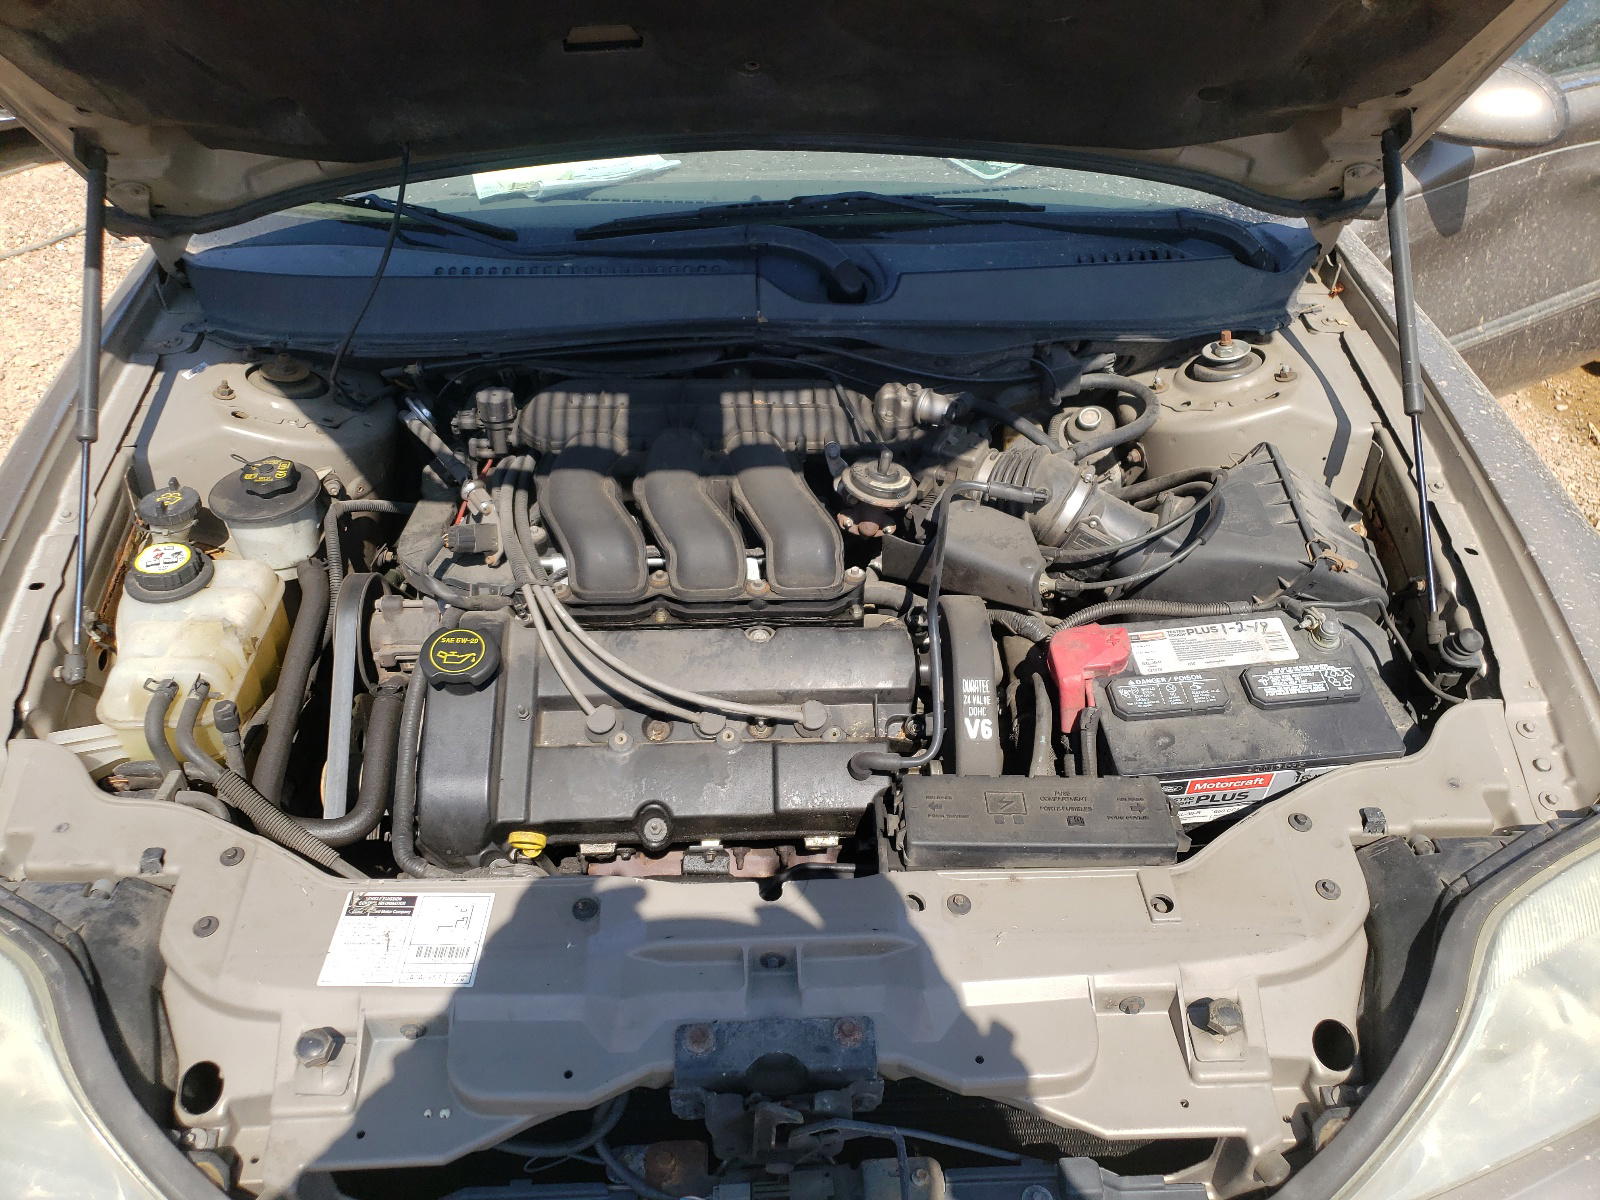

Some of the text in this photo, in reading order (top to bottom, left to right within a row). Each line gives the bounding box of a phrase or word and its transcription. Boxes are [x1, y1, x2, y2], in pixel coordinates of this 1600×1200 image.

[1186, 626, 1219, 636] PLUS
[962, 679, 990, 693] DURATEC
[1135, 677, 1167, 685] DANGER
[972, 694, 992, 705] VALVE
[968, 706, 987, 717] DOHC
[964, 717, 993, 740] V6
[1193, 777, 1265, 791] Motorcraft
[1195, 791, 1249, 804] PLUS
